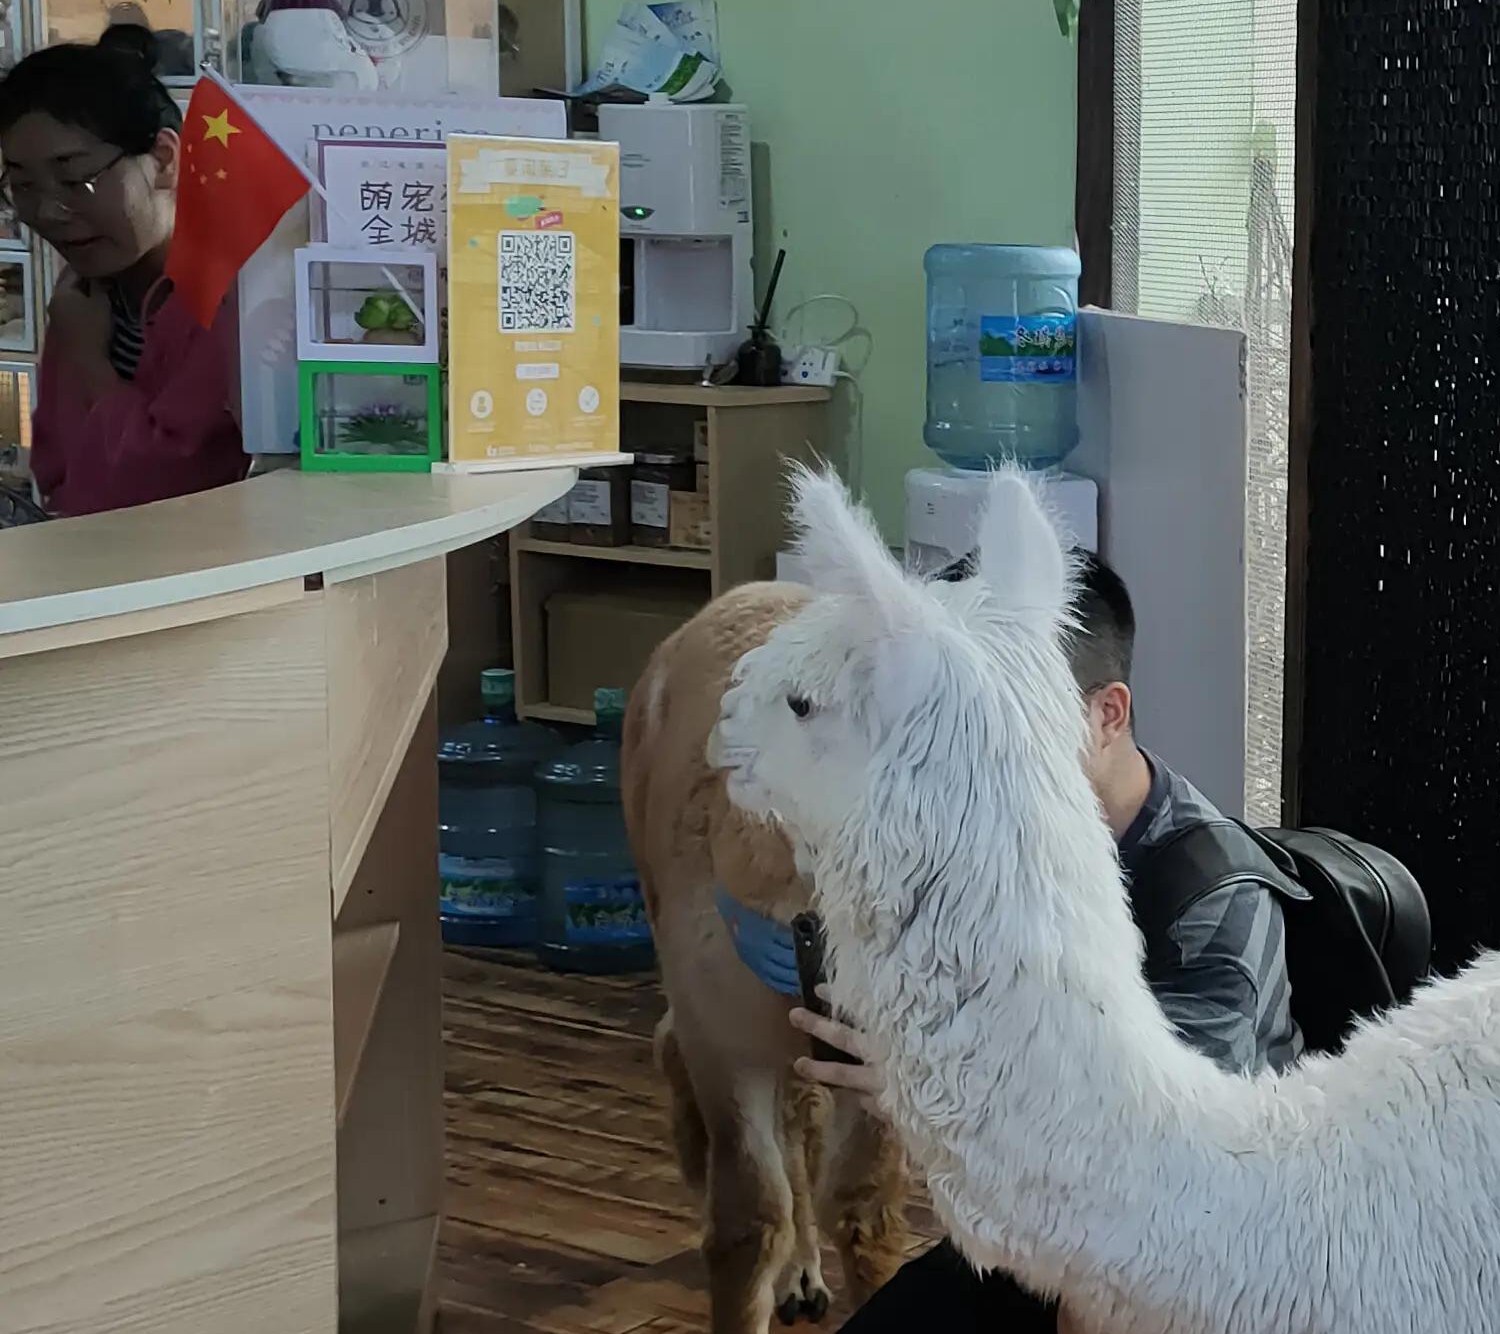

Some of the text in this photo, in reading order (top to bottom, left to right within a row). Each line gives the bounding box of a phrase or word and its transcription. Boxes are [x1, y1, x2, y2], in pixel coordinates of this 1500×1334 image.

[312, 120, 489, 141] peperi
[360, 180, 447, 212] 萌宠
[361, 214, 447, 245] 全城
